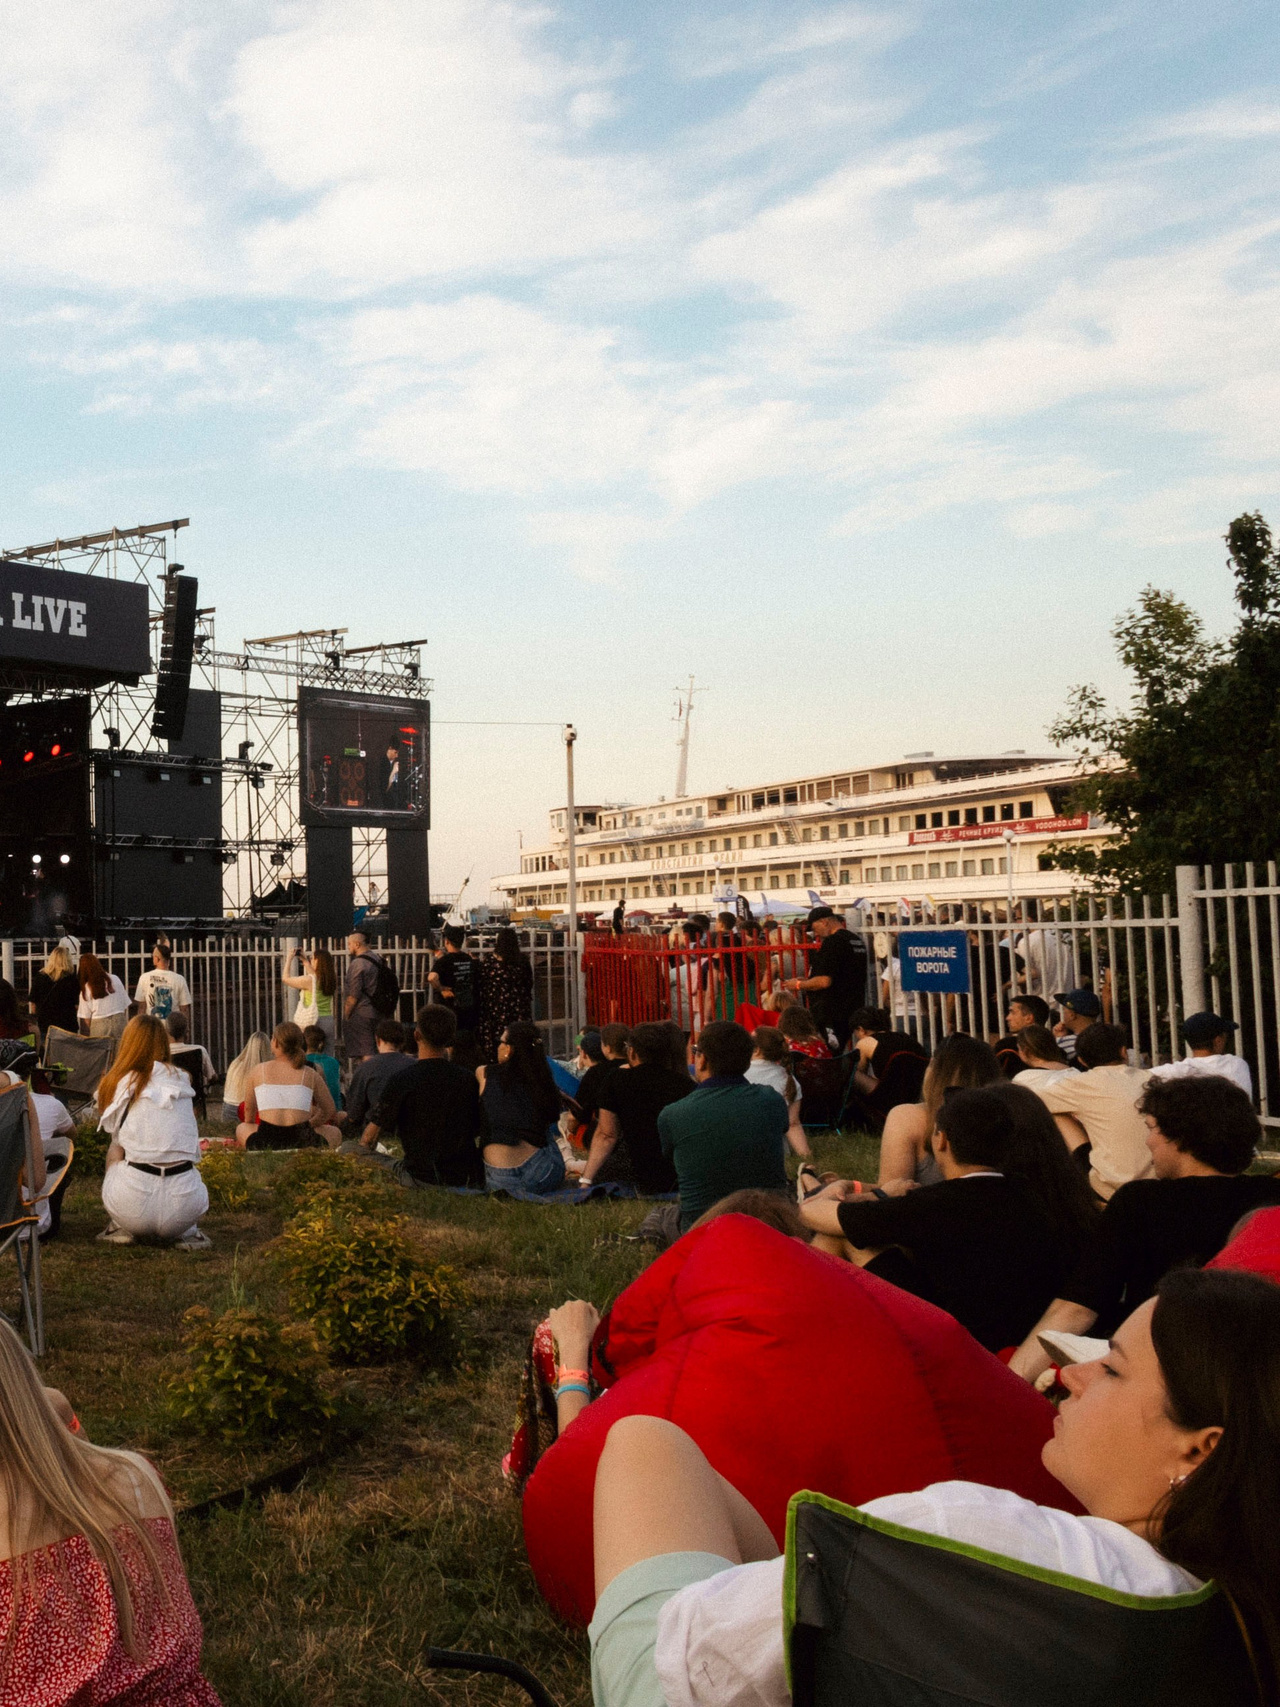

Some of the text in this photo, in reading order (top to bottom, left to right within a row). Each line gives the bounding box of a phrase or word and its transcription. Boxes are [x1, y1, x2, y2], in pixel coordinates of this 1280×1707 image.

[11, 591, 88, 638] LIVE
[1035, 818, 1083, 830] VODOHOD.COM
[725, 886, 734, 897] 6
[907, 946, 958, 959] ПОЖАРНЫЕ
[915, 962, 950, 974] ВОРОТА
